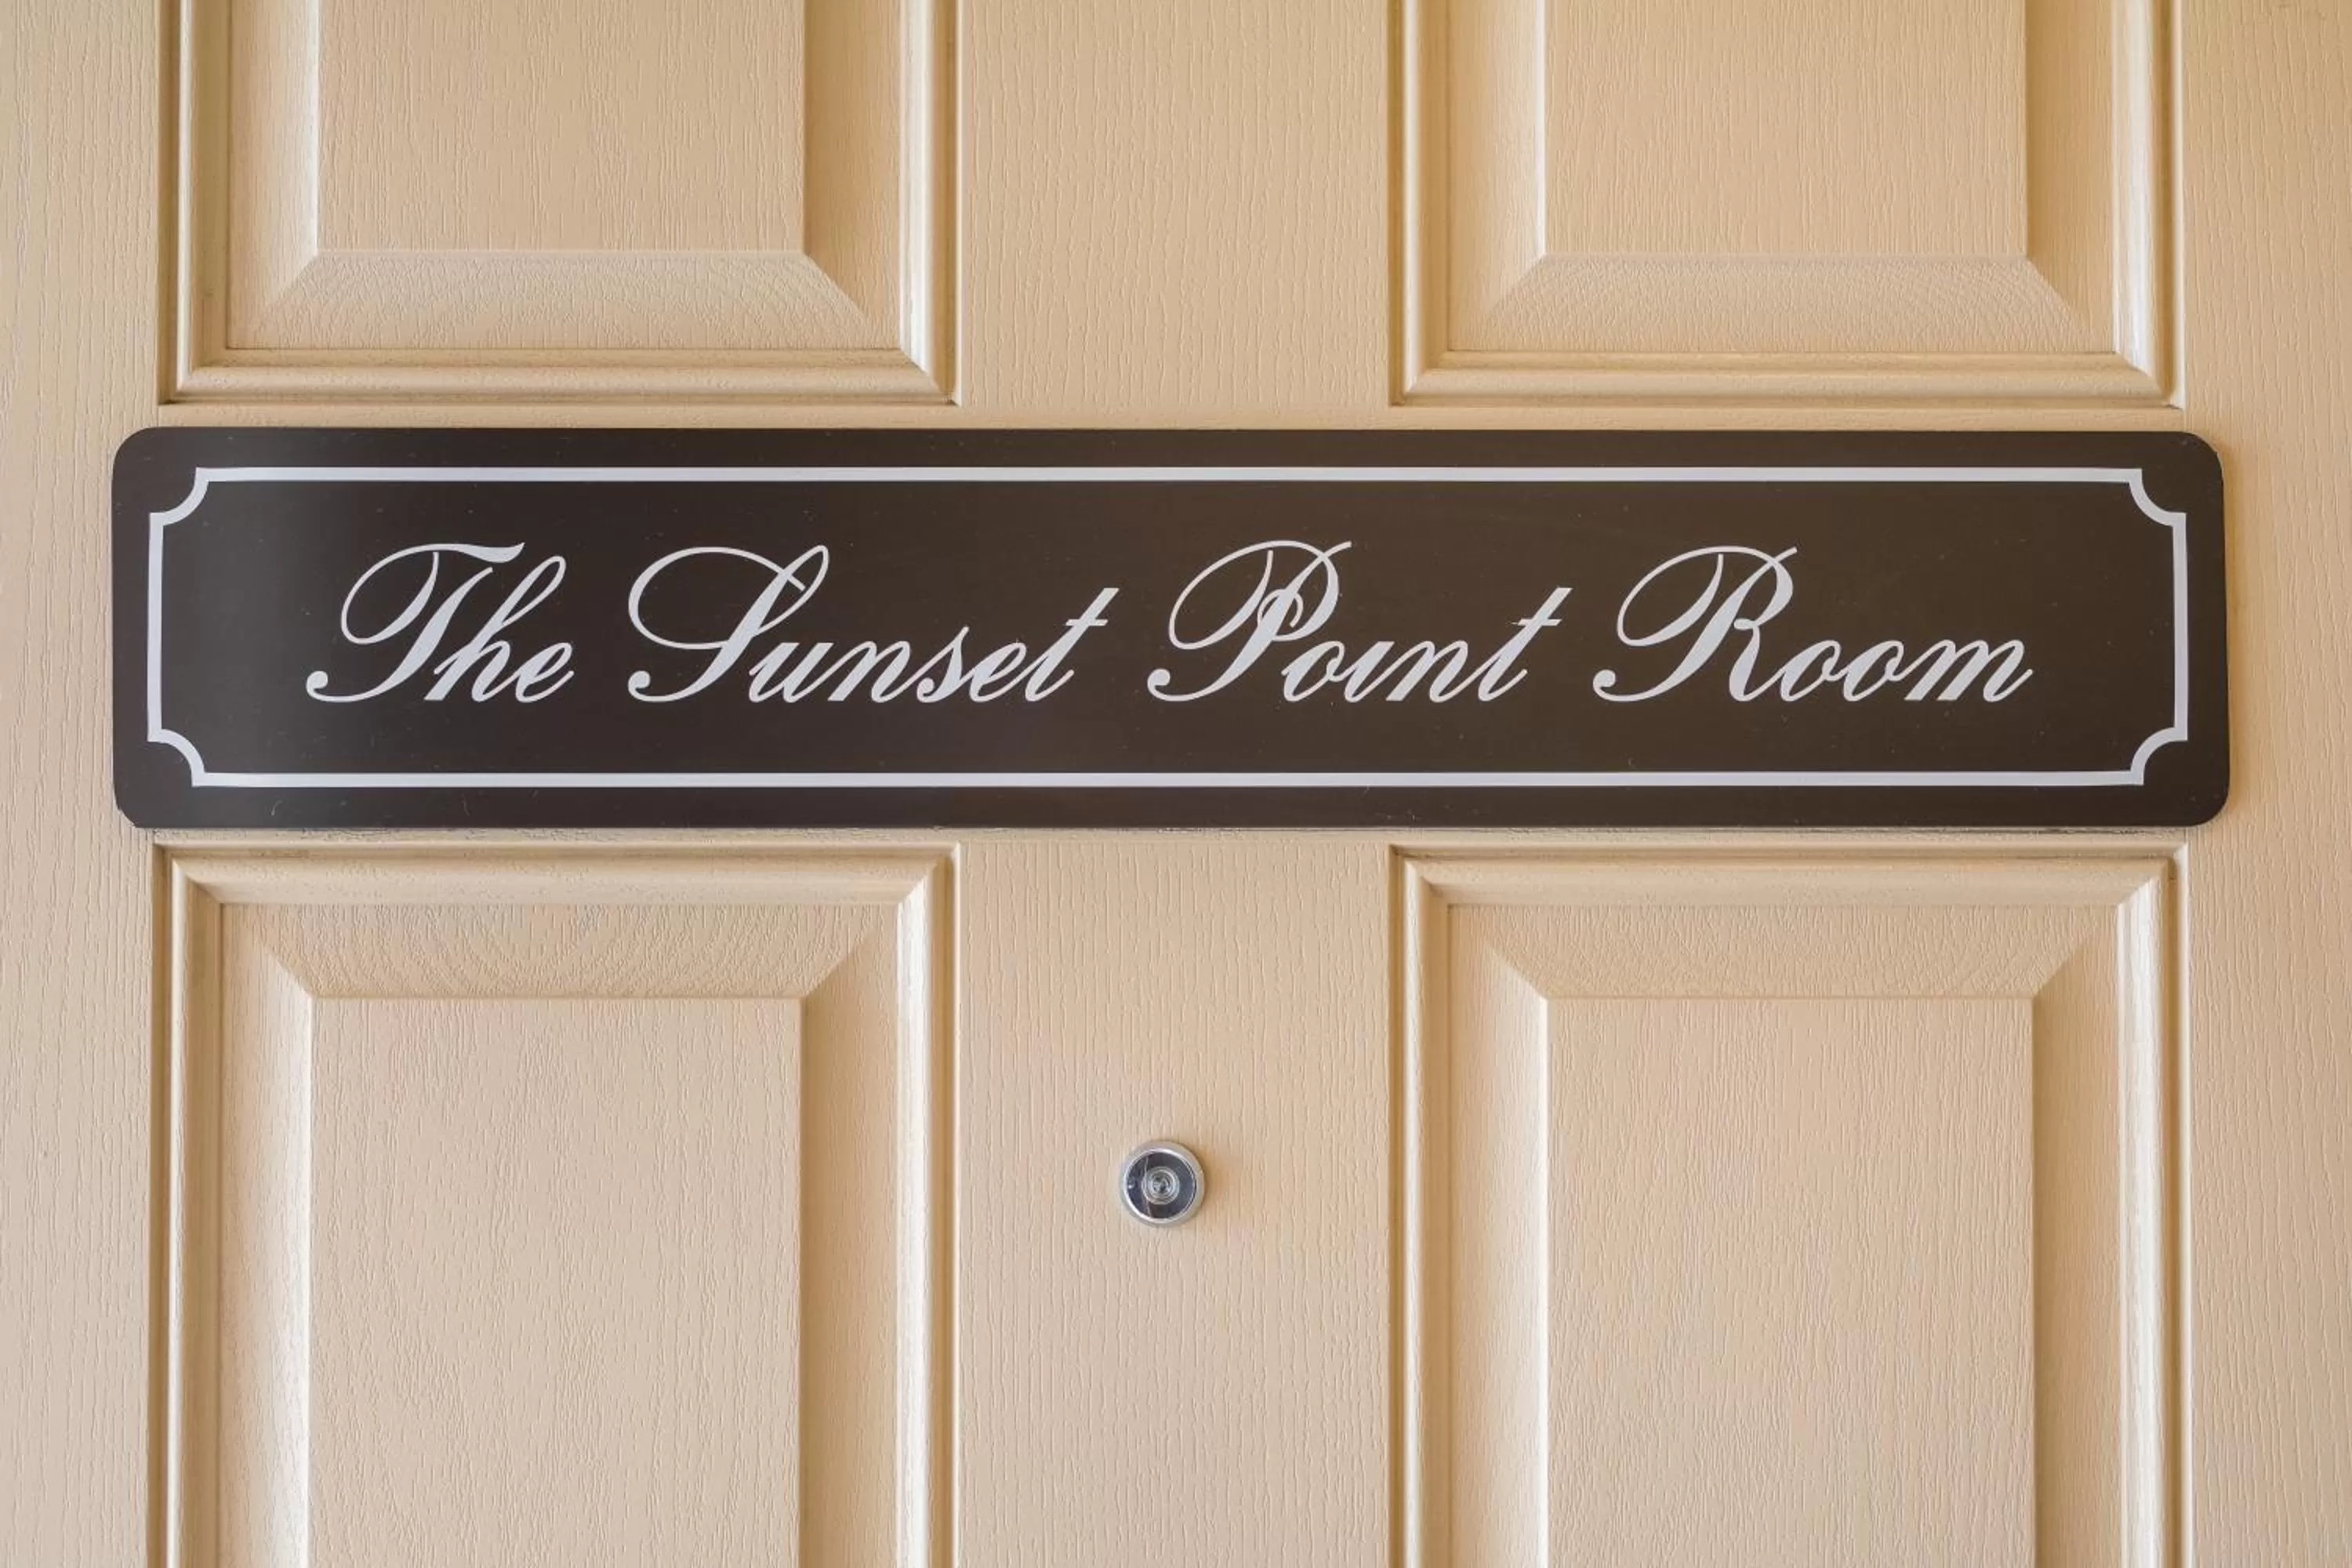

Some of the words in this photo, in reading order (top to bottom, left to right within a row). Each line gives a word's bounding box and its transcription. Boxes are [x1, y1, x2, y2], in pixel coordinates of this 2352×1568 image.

[306, 543, 575, 703] The
[628, 545, 1120, 703] Sunset
[1148, 540, 1573, 703] Point
[1592, 546, 2034, 702] Room
